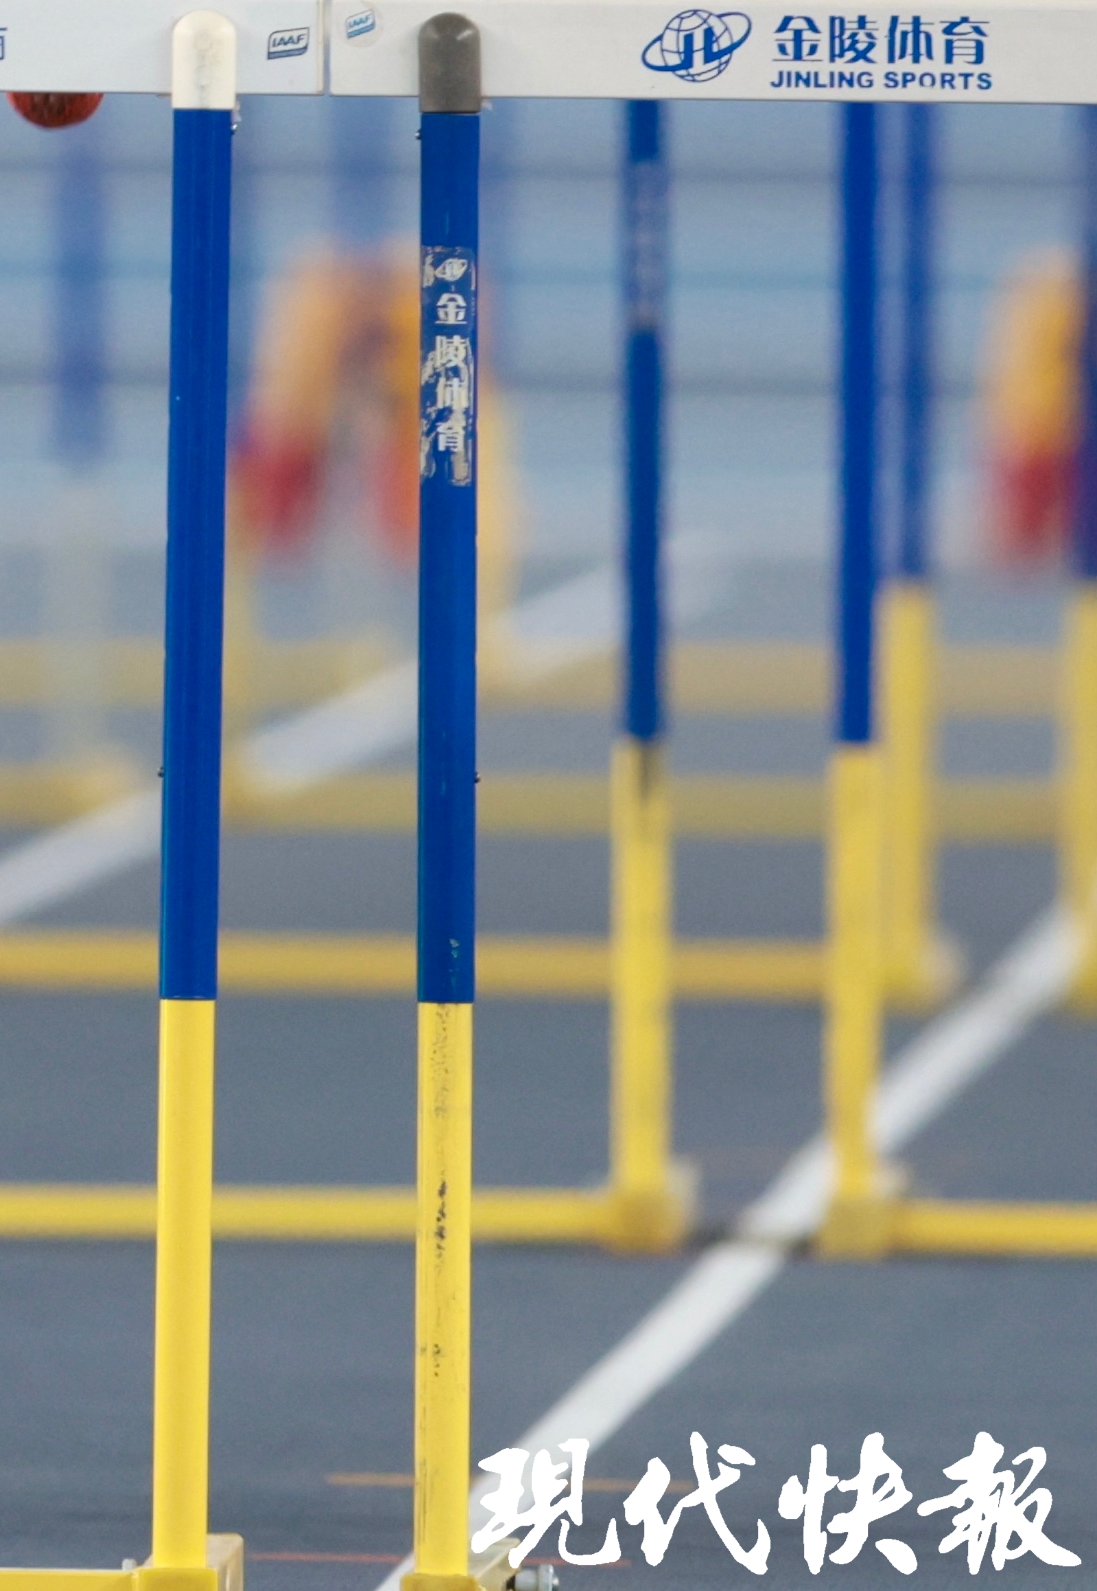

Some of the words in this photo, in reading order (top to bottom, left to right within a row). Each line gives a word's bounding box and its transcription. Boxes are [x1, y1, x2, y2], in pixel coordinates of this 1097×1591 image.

[273, 34, 305, 47] IAAF
[771, 14, 991, 66] 金陵体育
[770, 70, 874, 89] JINLING
[883, 72, 993, 91] SPORTS
[434, 292, 469, 453] 金陵体育
